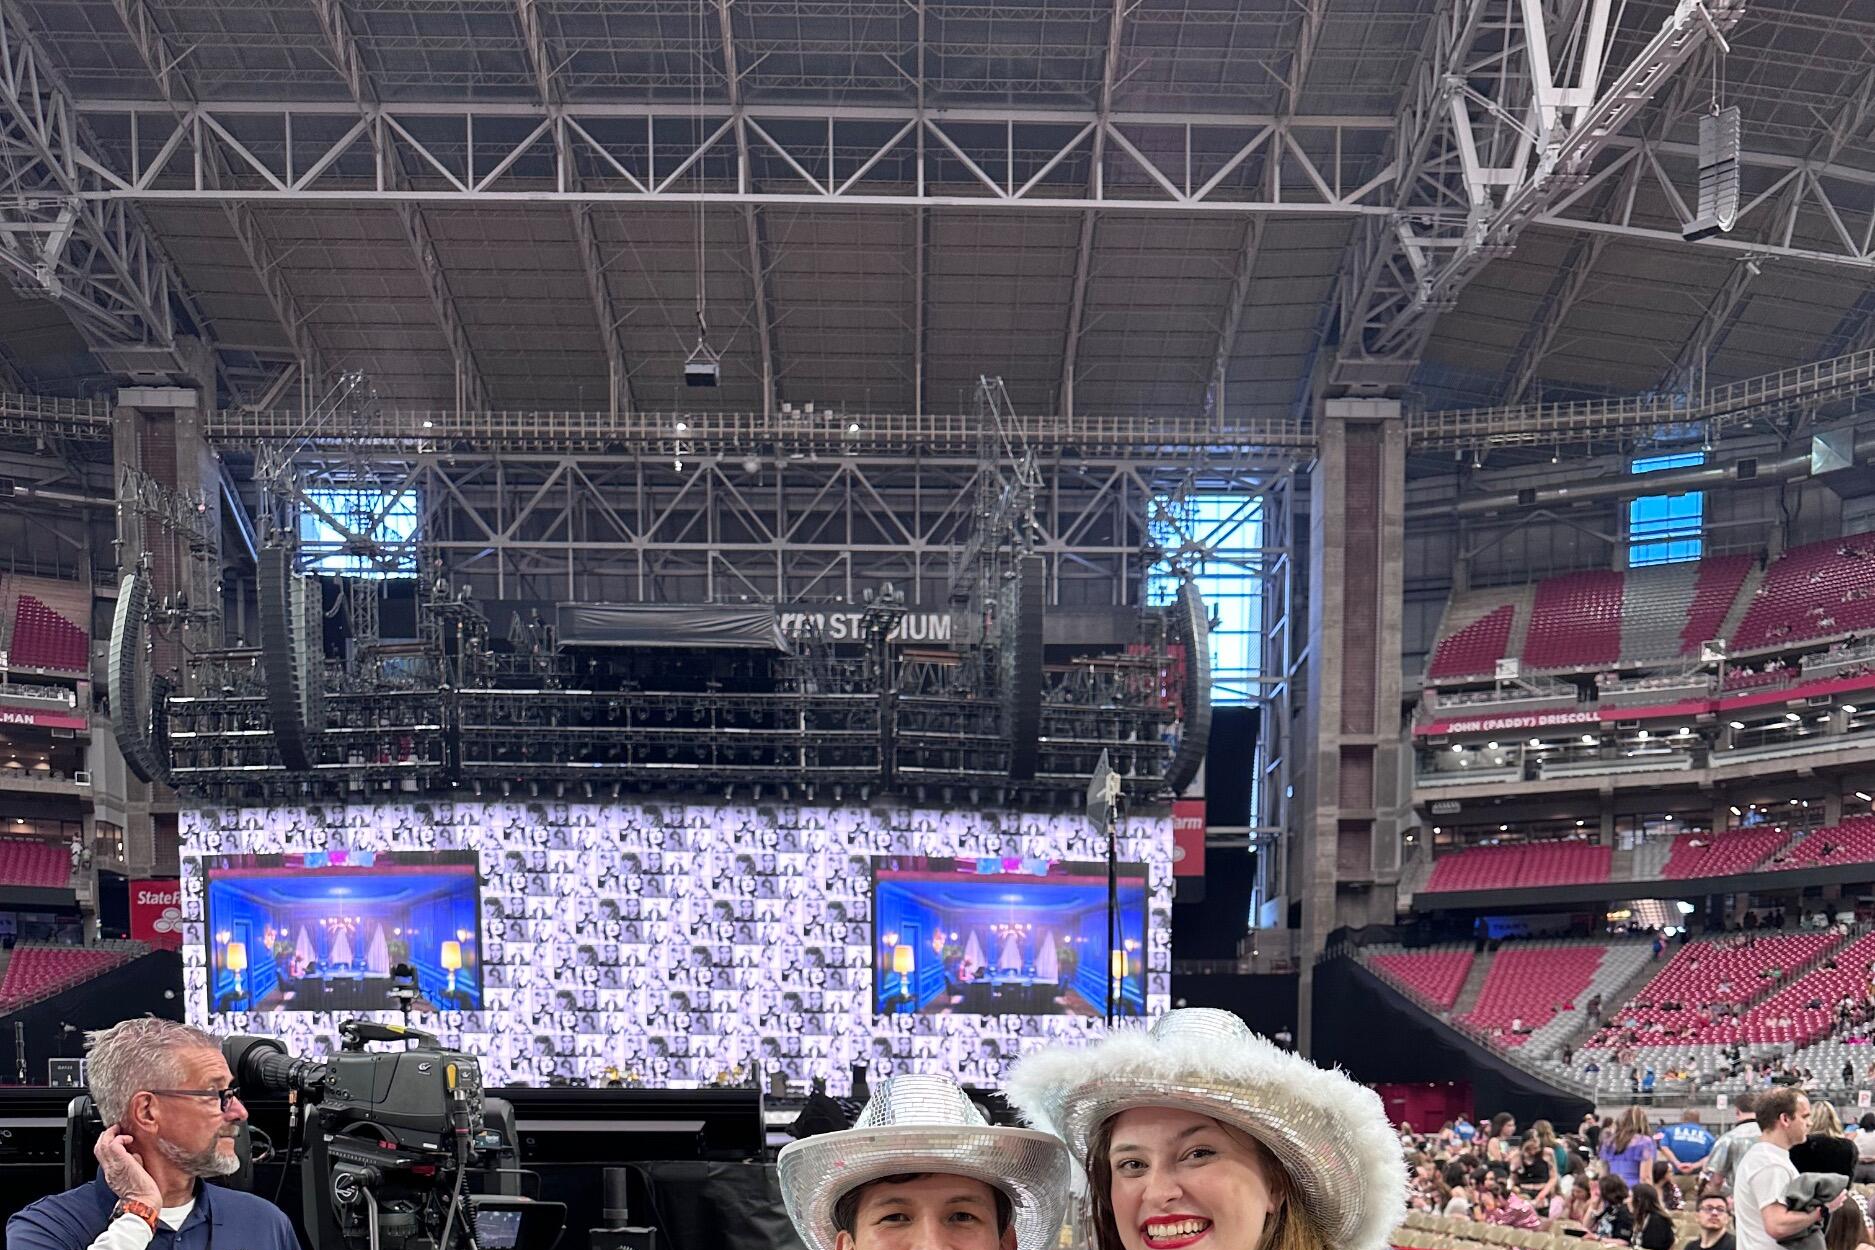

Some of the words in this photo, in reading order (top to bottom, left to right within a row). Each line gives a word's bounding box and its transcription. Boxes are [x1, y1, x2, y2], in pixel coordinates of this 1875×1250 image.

[830, 613, 950, 640] STIUM
[0, 713, 34, 724] MAN
[1448, 721, 1481, 733] JOHN
[1483, 717, 1536, 731] (PADDY)
[1539, 712, 1601, 727] DRISCOLL
[137, 891, 182, 905] StateF
